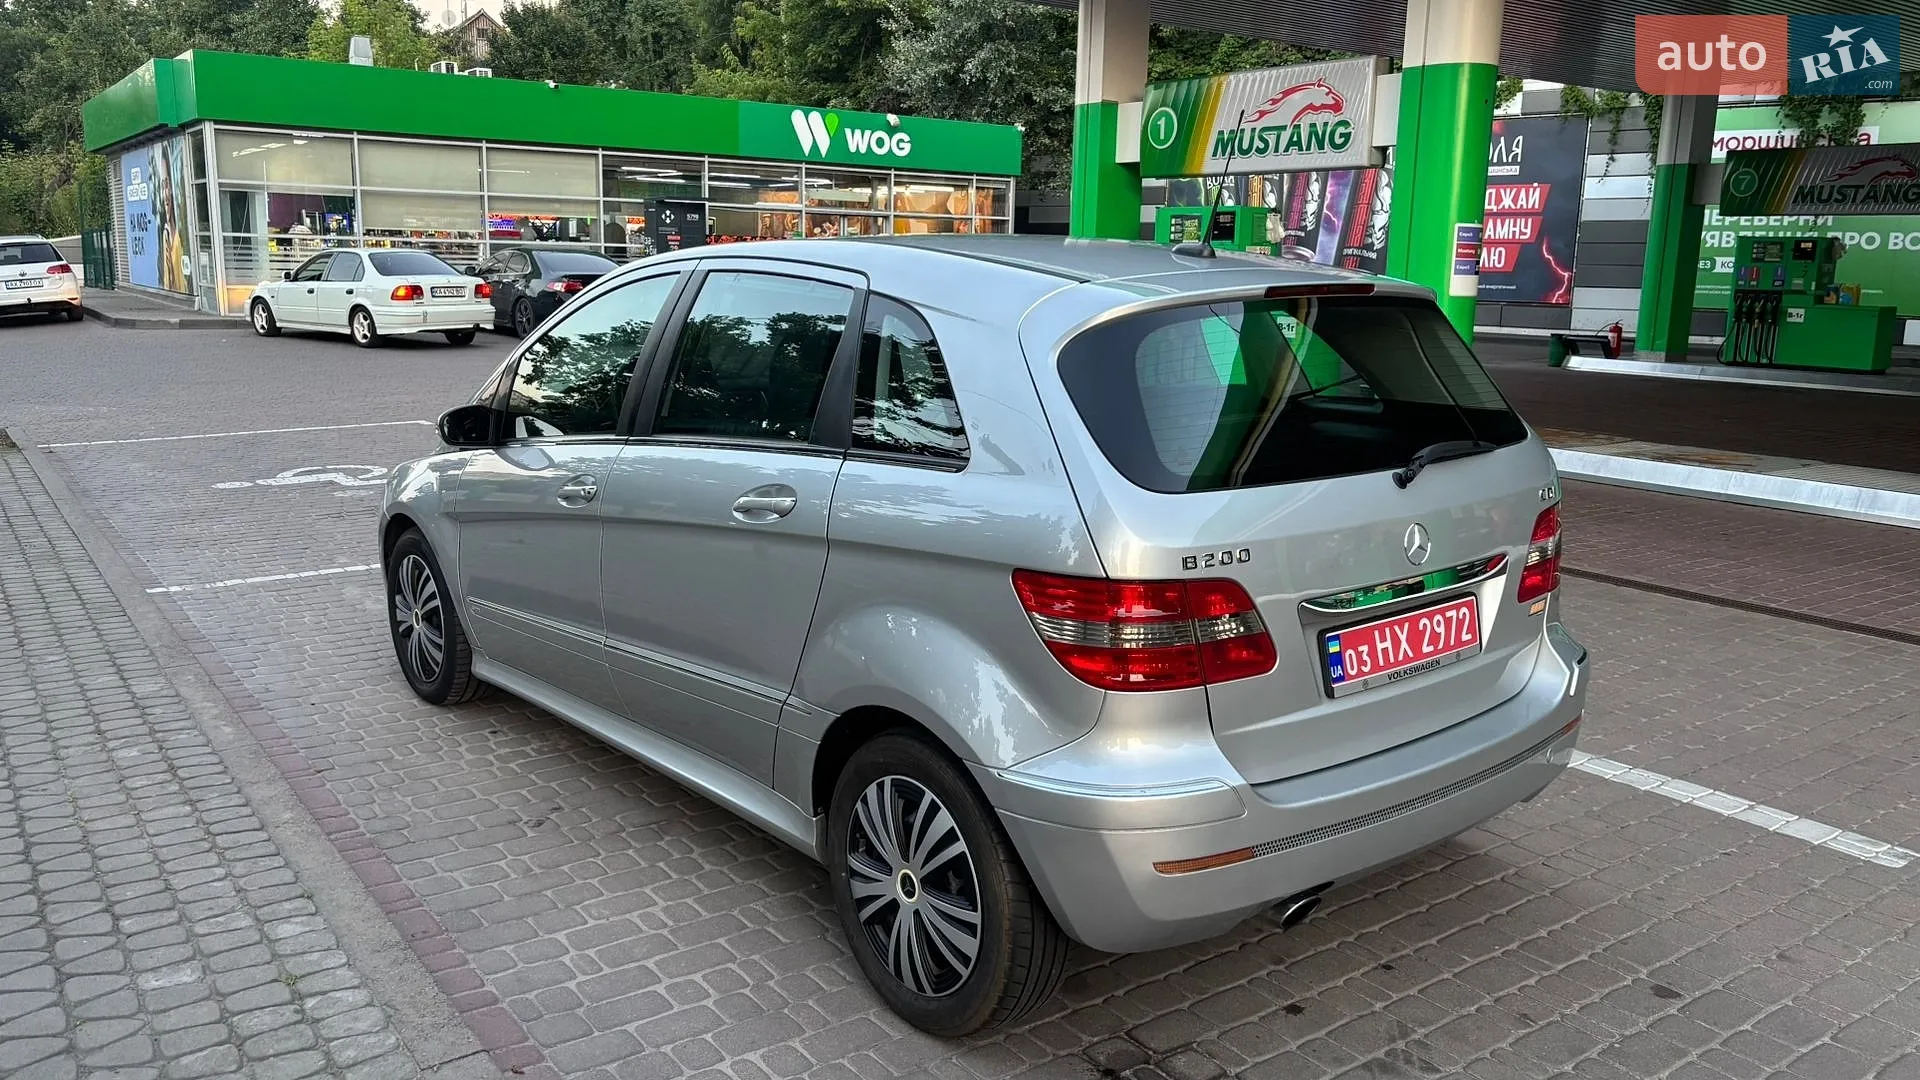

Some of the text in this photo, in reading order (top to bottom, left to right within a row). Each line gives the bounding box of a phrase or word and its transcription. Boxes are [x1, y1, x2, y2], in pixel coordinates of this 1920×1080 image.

[1156, 116, 1166, 140] 1
[1211, 118, 1355, 160] MUSTANG
[844, 127, 912, 157] WOG
[1488, 135, 1524, 163] ЛЯ
[1738, 175, 1750, 191] 7
[1791, 183, 1920, 205] MUSTANG
[1484, 182, 1541, 212] ДЖАЙ
[1484, 216, 1533, 240] АМНУ
[1330, 606, 1473, 679] UA 03 HX 2972
[1387, 658, 1441, 681] VOLKSWAGEN
